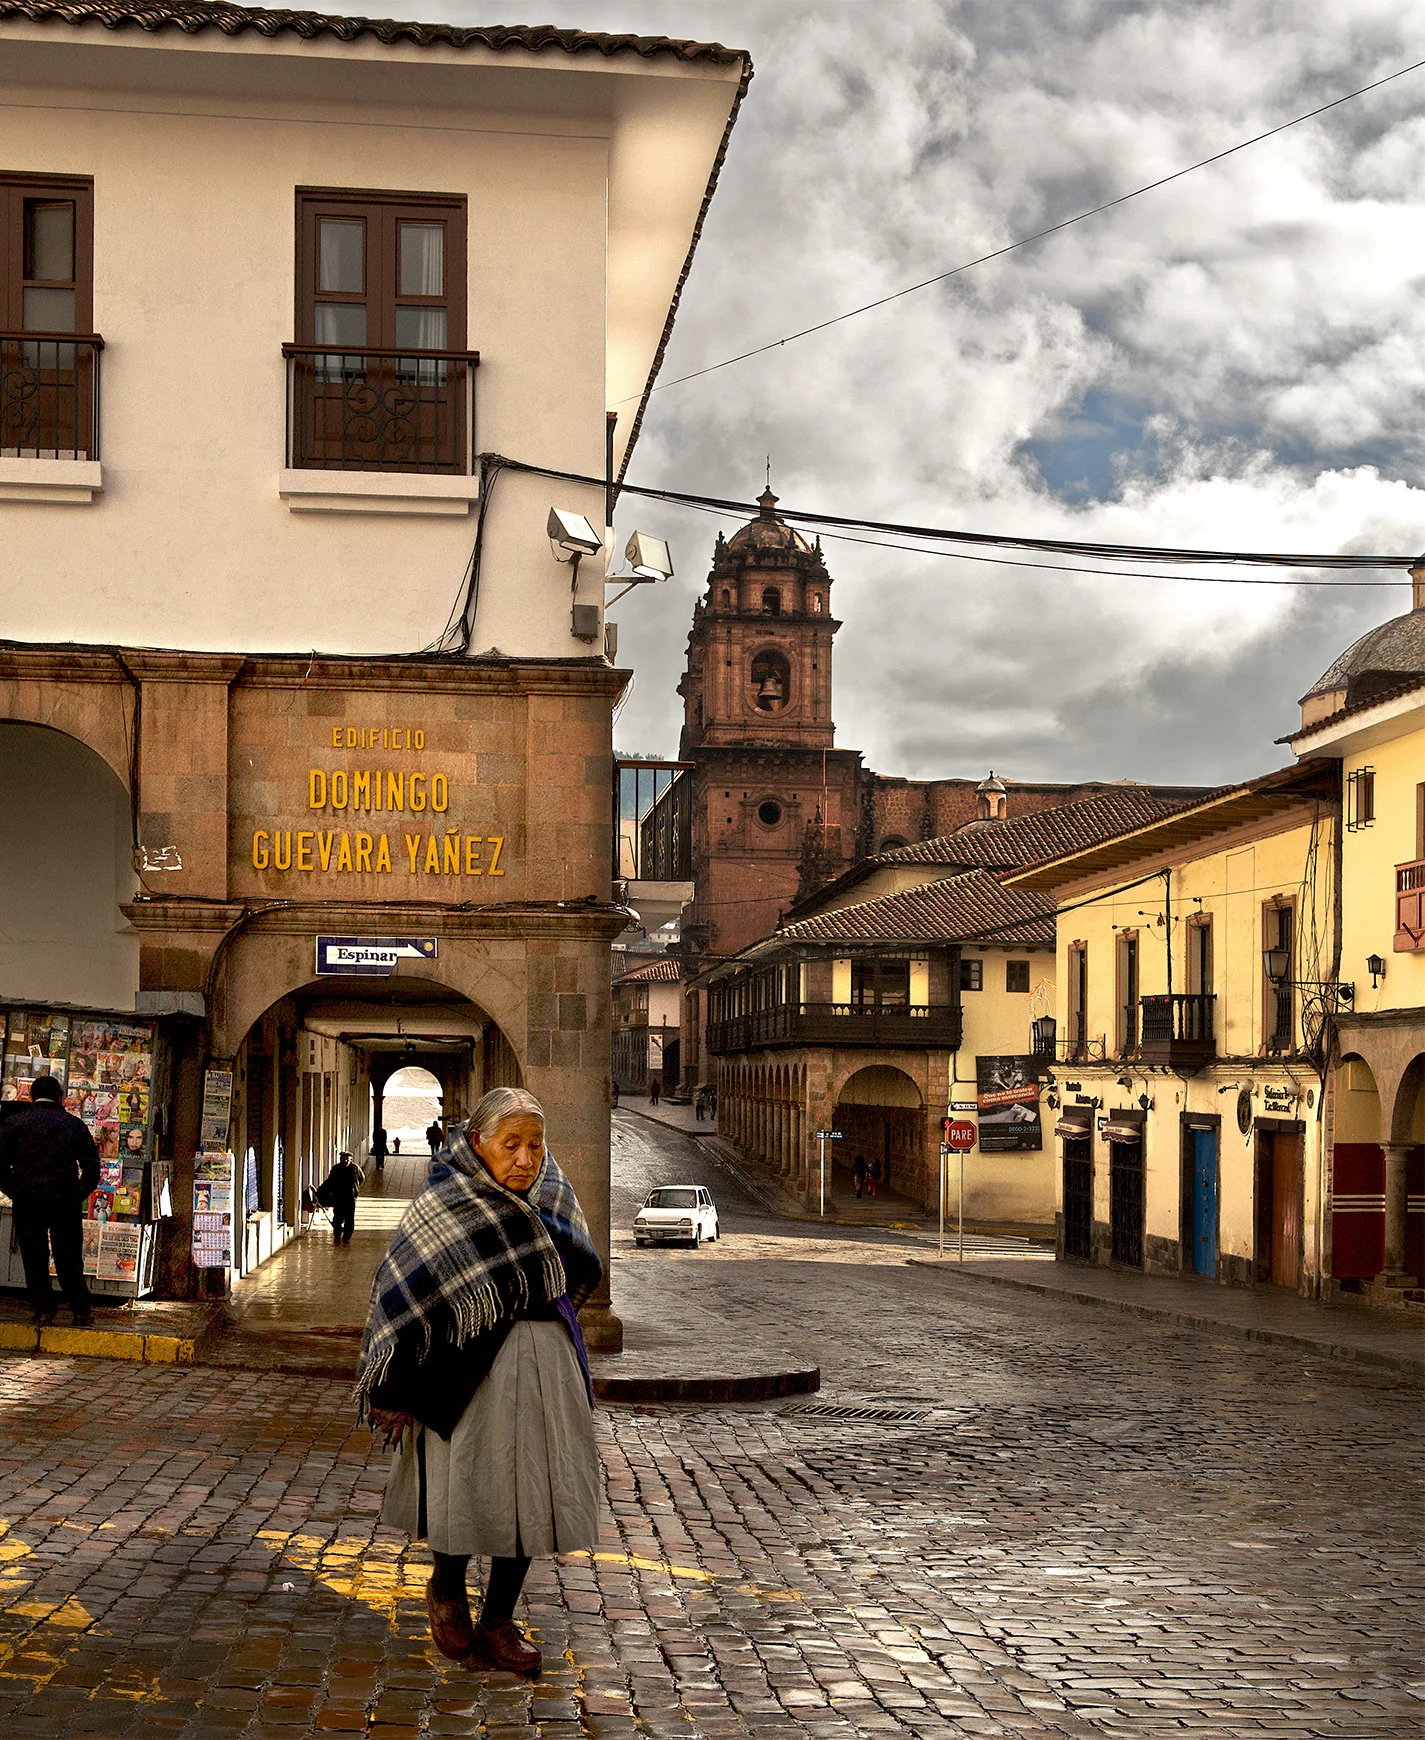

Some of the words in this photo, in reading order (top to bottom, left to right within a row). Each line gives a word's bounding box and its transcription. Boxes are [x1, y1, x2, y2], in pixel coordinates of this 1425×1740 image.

[332, 727, 426, 750] EDIFICIO
[309, 769, 449, 812] DOMINGO
[252, 830, 392, 873] GUEVARA
[405, 828, 505, 876] YAÑEZ
[337, 947, 398, 964] Espinar
[951, 1129, 973, 1141] PARE
